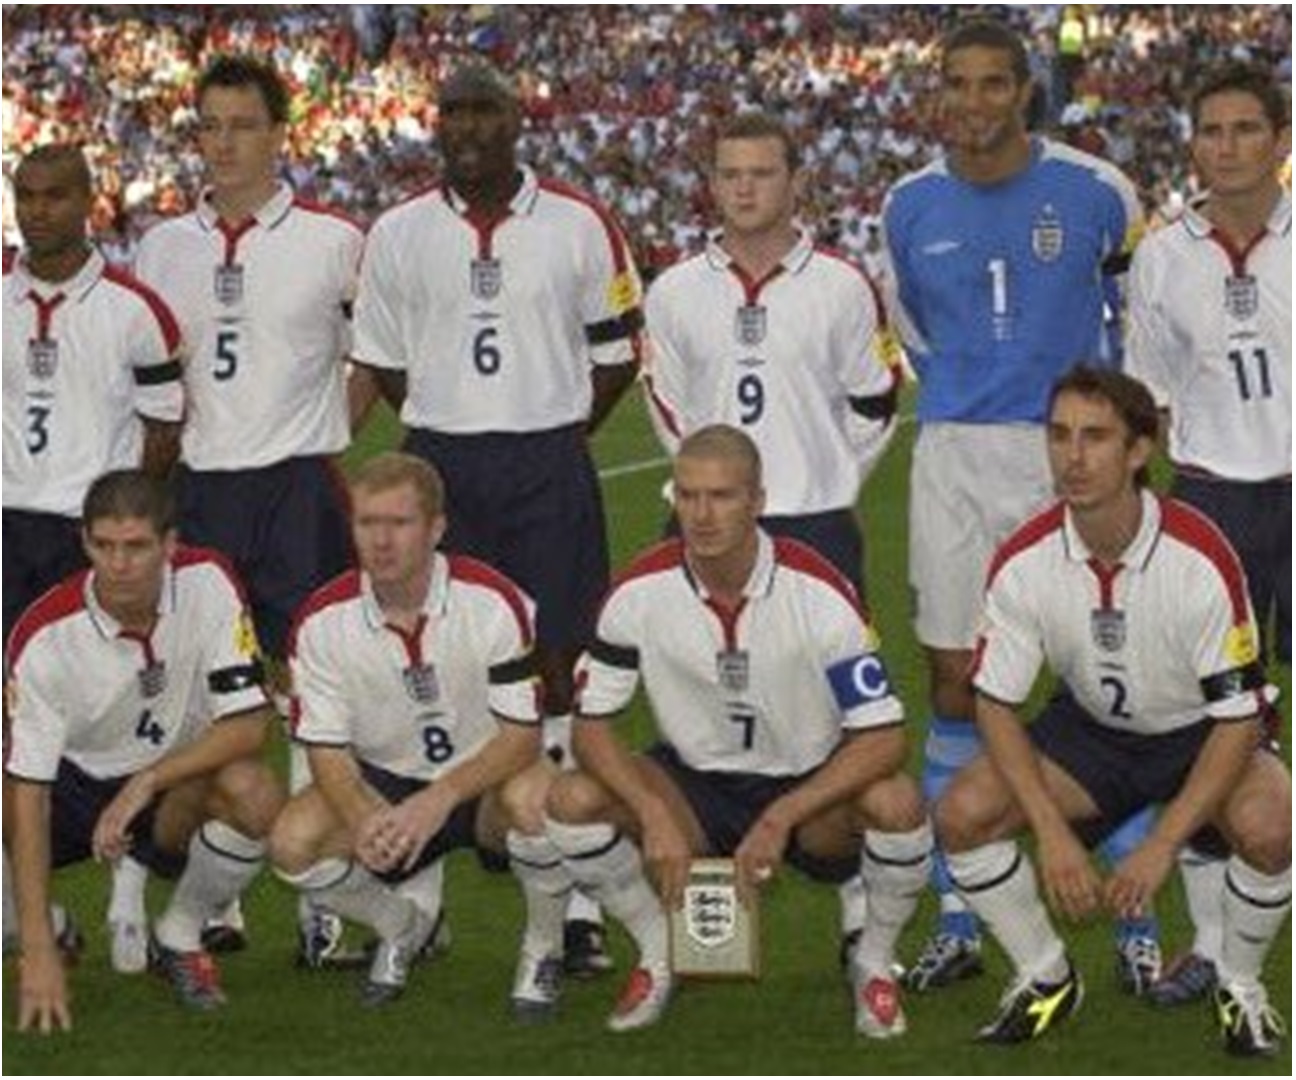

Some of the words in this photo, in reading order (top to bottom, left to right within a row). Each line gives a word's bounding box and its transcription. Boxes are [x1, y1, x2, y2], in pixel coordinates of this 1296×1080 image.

[987, 258, 1007, 314] 1
[213, 331, 238, 381] 5
[473, 326, 501, 376] 6
[1227, 348, 1273, 401] 11
[736, 374, 765, 425] 9
[26, 406, 49, 455] 3
[852, 656, 888, 697] C
[1100, 676, 1132, 720] 2
[135, 709, 163, 746] 4
[422, 725, 453, 764] 8
[730, 713, 755, 751] 7
